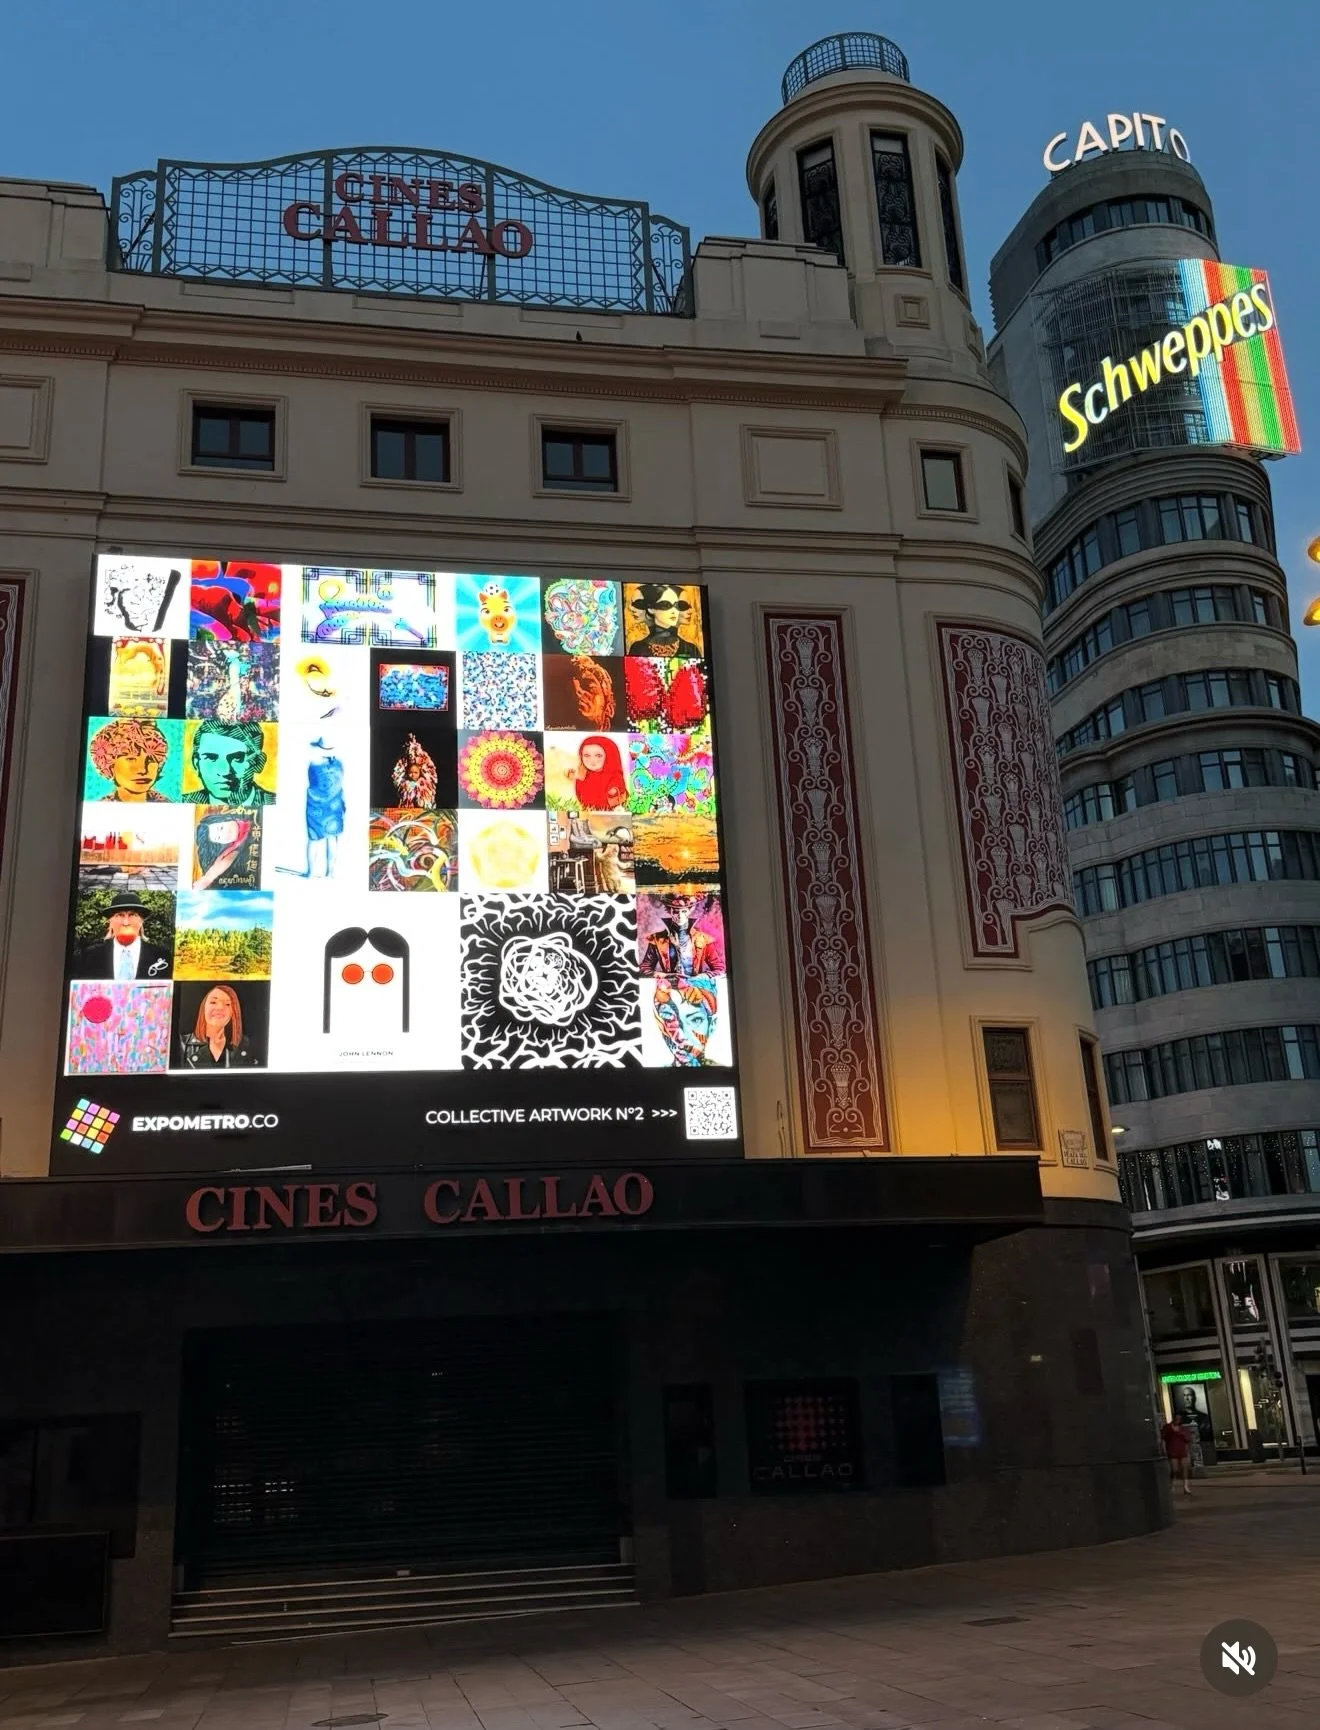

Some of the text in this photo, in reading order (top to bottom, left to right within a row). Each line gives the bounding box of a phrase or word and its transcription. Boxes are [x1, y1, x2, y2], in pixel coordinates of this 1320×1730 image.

[1043, 112, 1191, 174] CAPITO
[335, 172, 485, 213] CINES
[283, 202, 534, 259] CALLAO
[1058, 282, 1274, 454] Schweppes
[132, 1114, 279, 1132] EXPOMETRO.CO
[425, 1108, 526, 1124] COLLECTIVE
[529, 1107, 612, 1122] ARTWORK
[184, 1172, 655, 1234] CINES CALLAO
[753, 1462, 854, 1481] CALLAO
